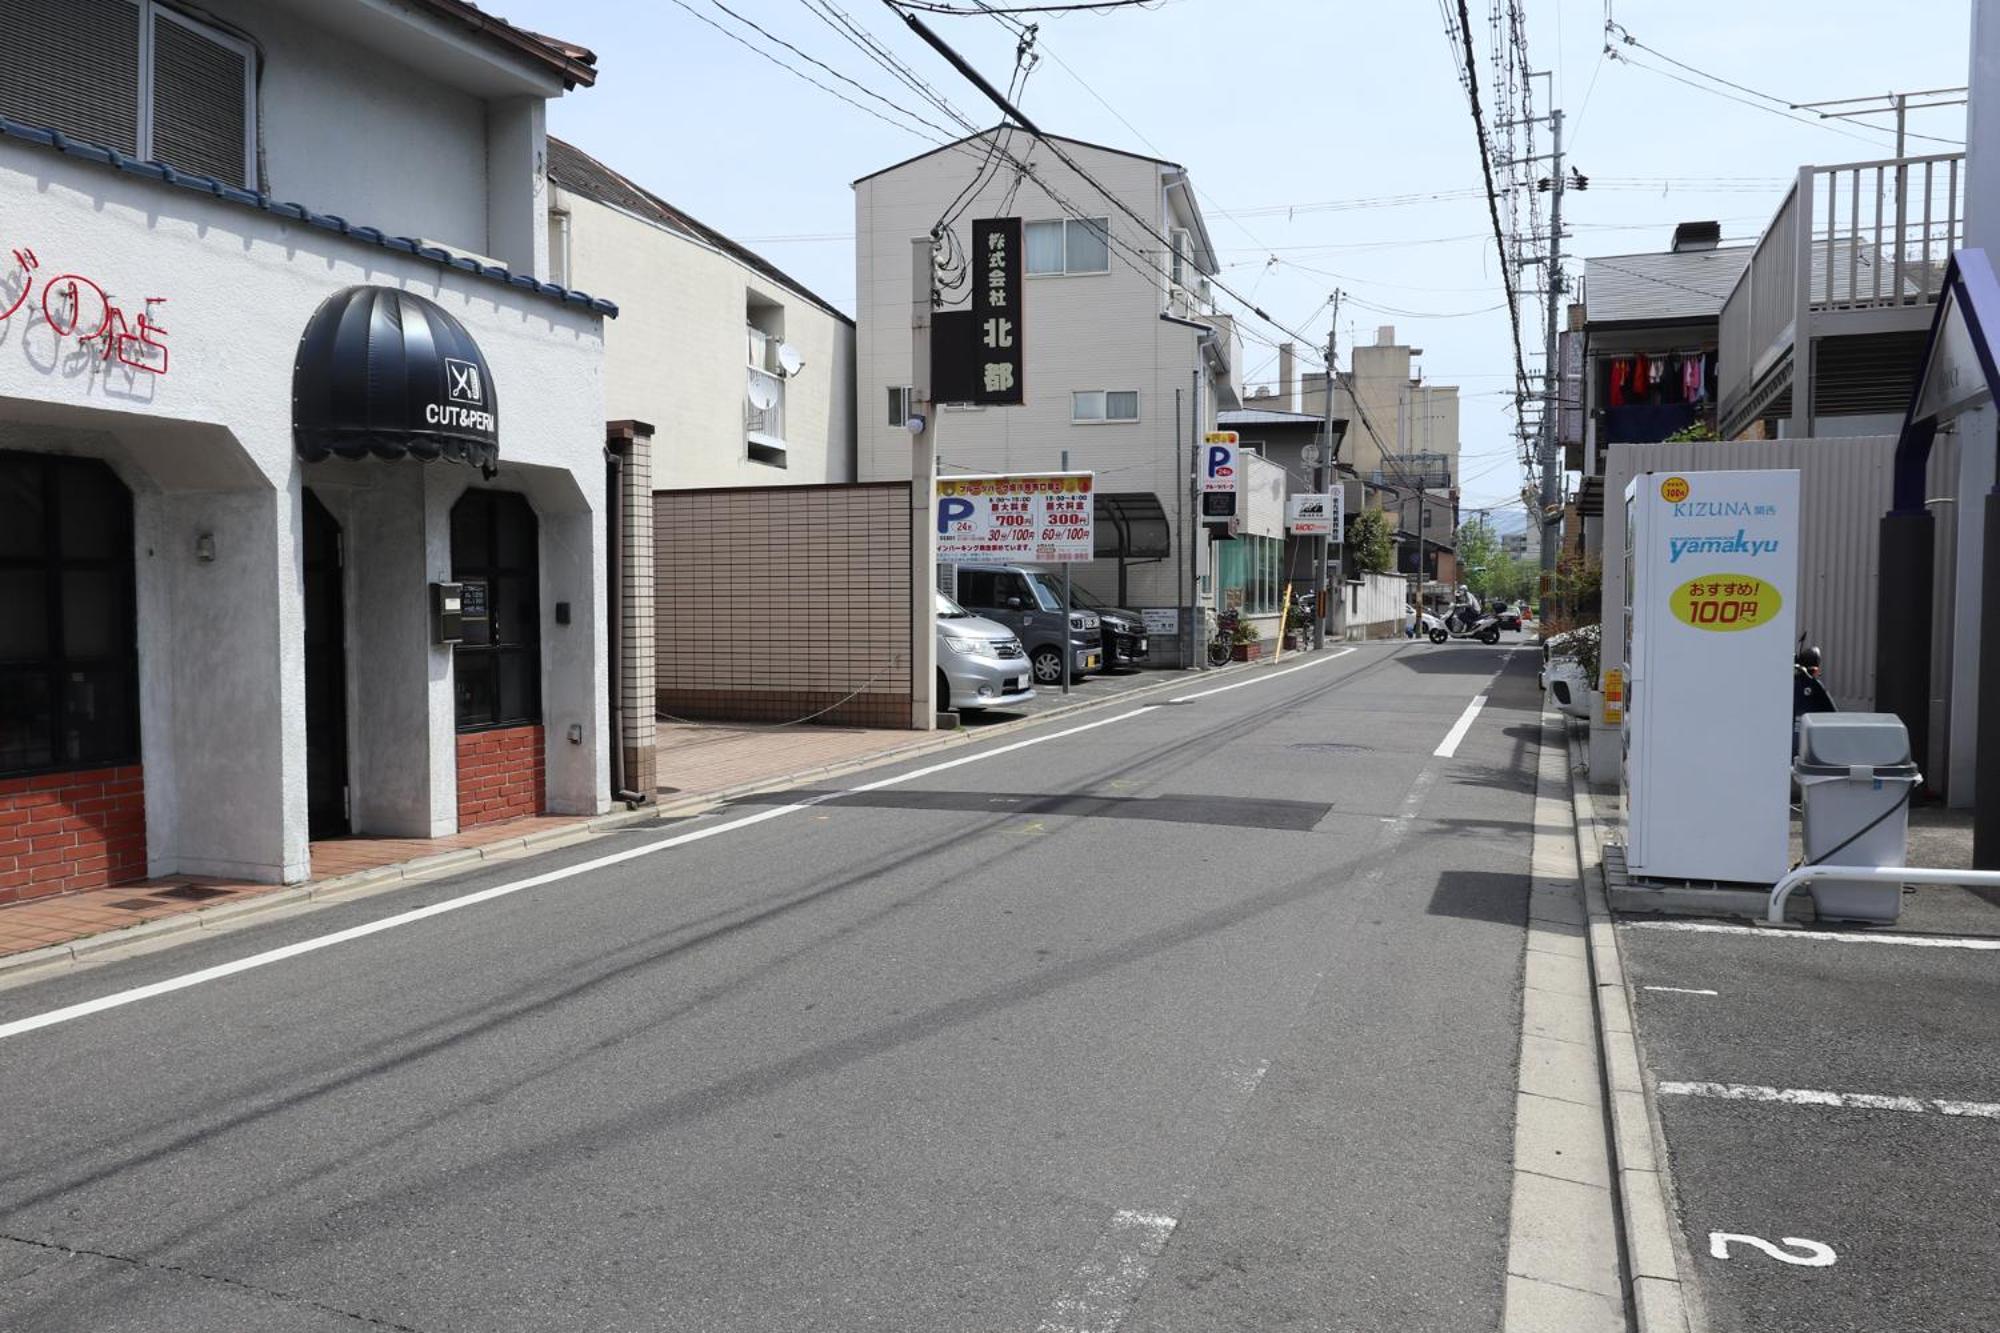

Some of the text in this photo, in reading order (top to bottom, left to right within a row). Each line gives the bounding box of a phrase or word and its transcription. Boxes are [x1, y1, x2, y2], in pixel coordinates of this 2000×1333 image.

[983, 232, 1014, 392] 株式会社北都
[1208, 446, 1231, 478] P
[937, 497, 975, 534] P
[996, 514, 1032, 526] 700円
[1048, 513, 1089, 526] 300円
[1674, 502, 1751, 517] KIZUNA
[1669, 529, 1778, 563] yamakyu
[1708, 1232, 1838, 1267] 2
